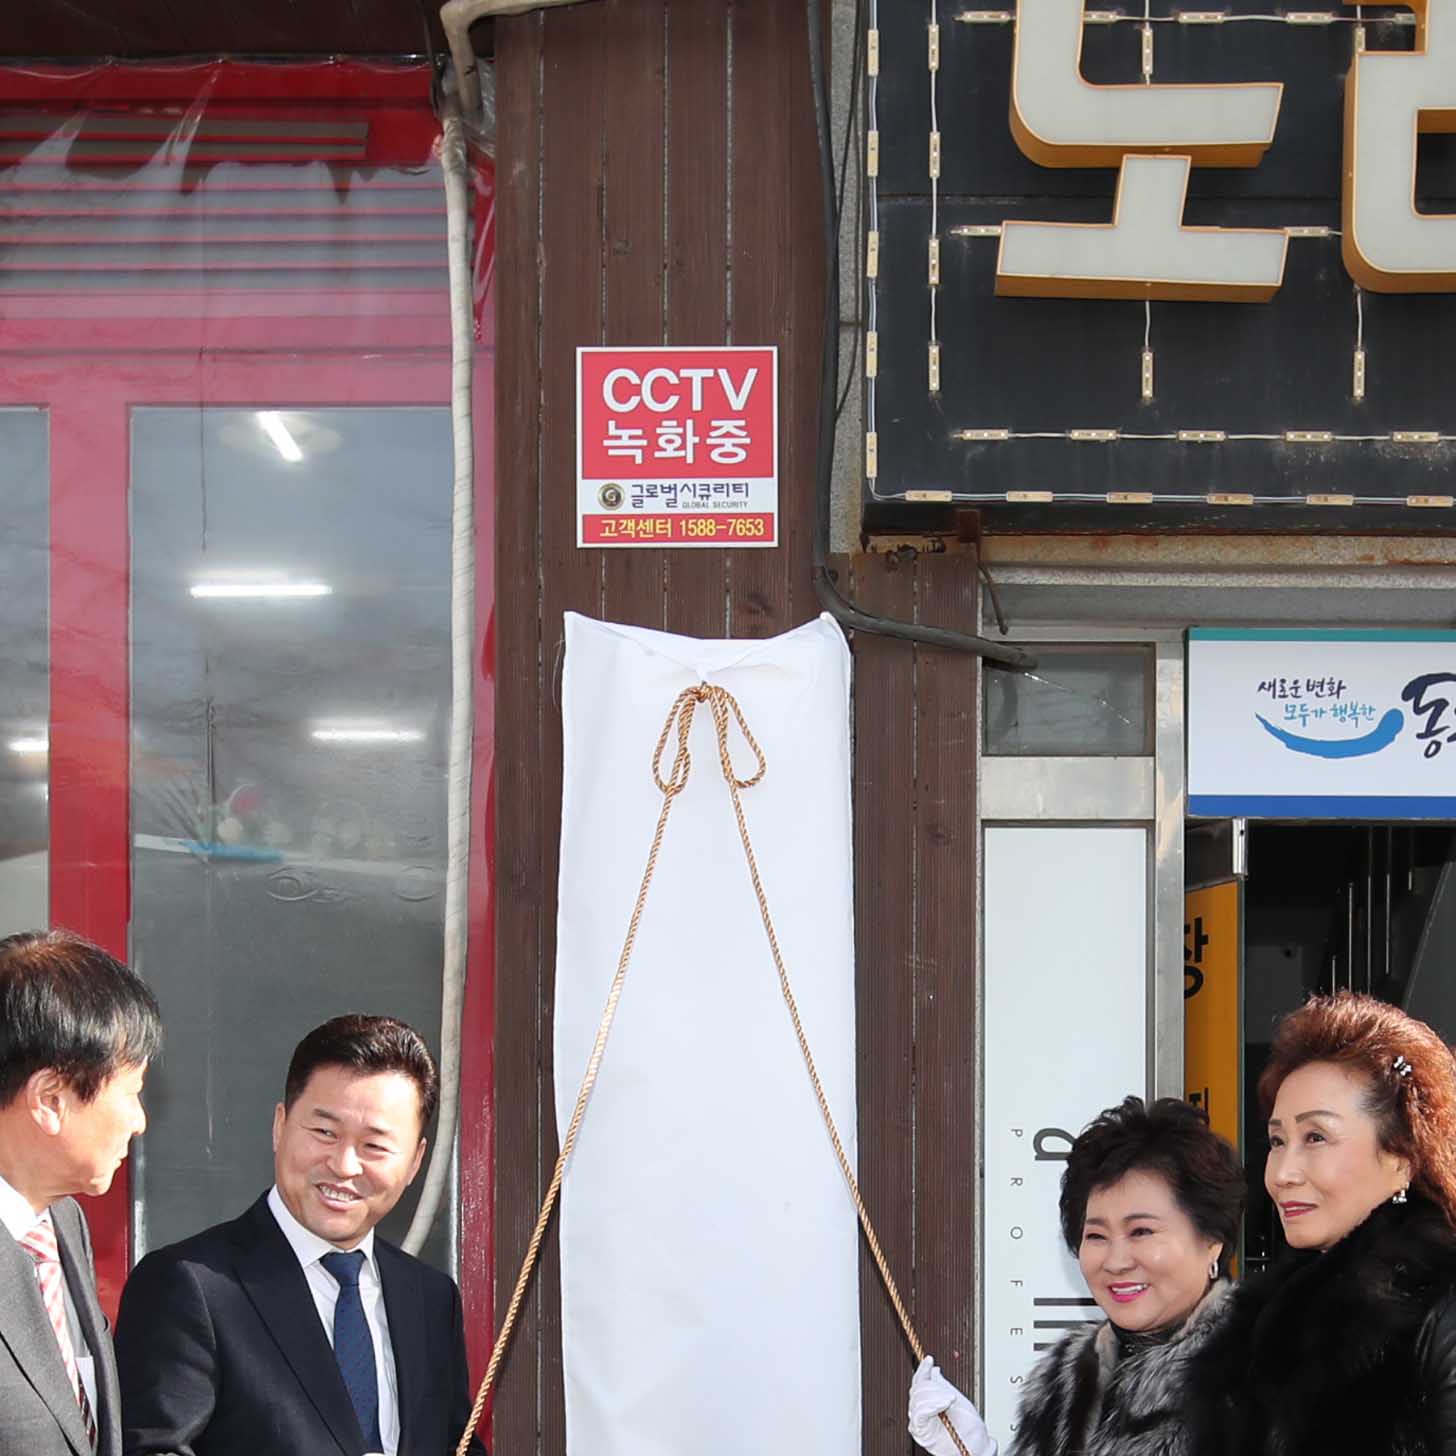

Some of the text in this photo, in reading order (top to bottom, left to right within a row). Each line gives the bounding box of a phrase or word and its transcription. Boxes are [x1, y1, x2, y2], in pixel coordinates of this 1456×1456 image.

[602, 367, 758, 412] CCTV
[602, 418, 752, 465] 녹화중
[631, 482, 749, 509] 글로벌시큐리티
[682, 500, 748, 509] GLOBAL SECURITY
[599, 518, 765, 538] 고객센터 1588-7653
[1257, 677, 1347, 699] 새로운 변화
[1284, 701, 1376, 728] 모두가 행복한
